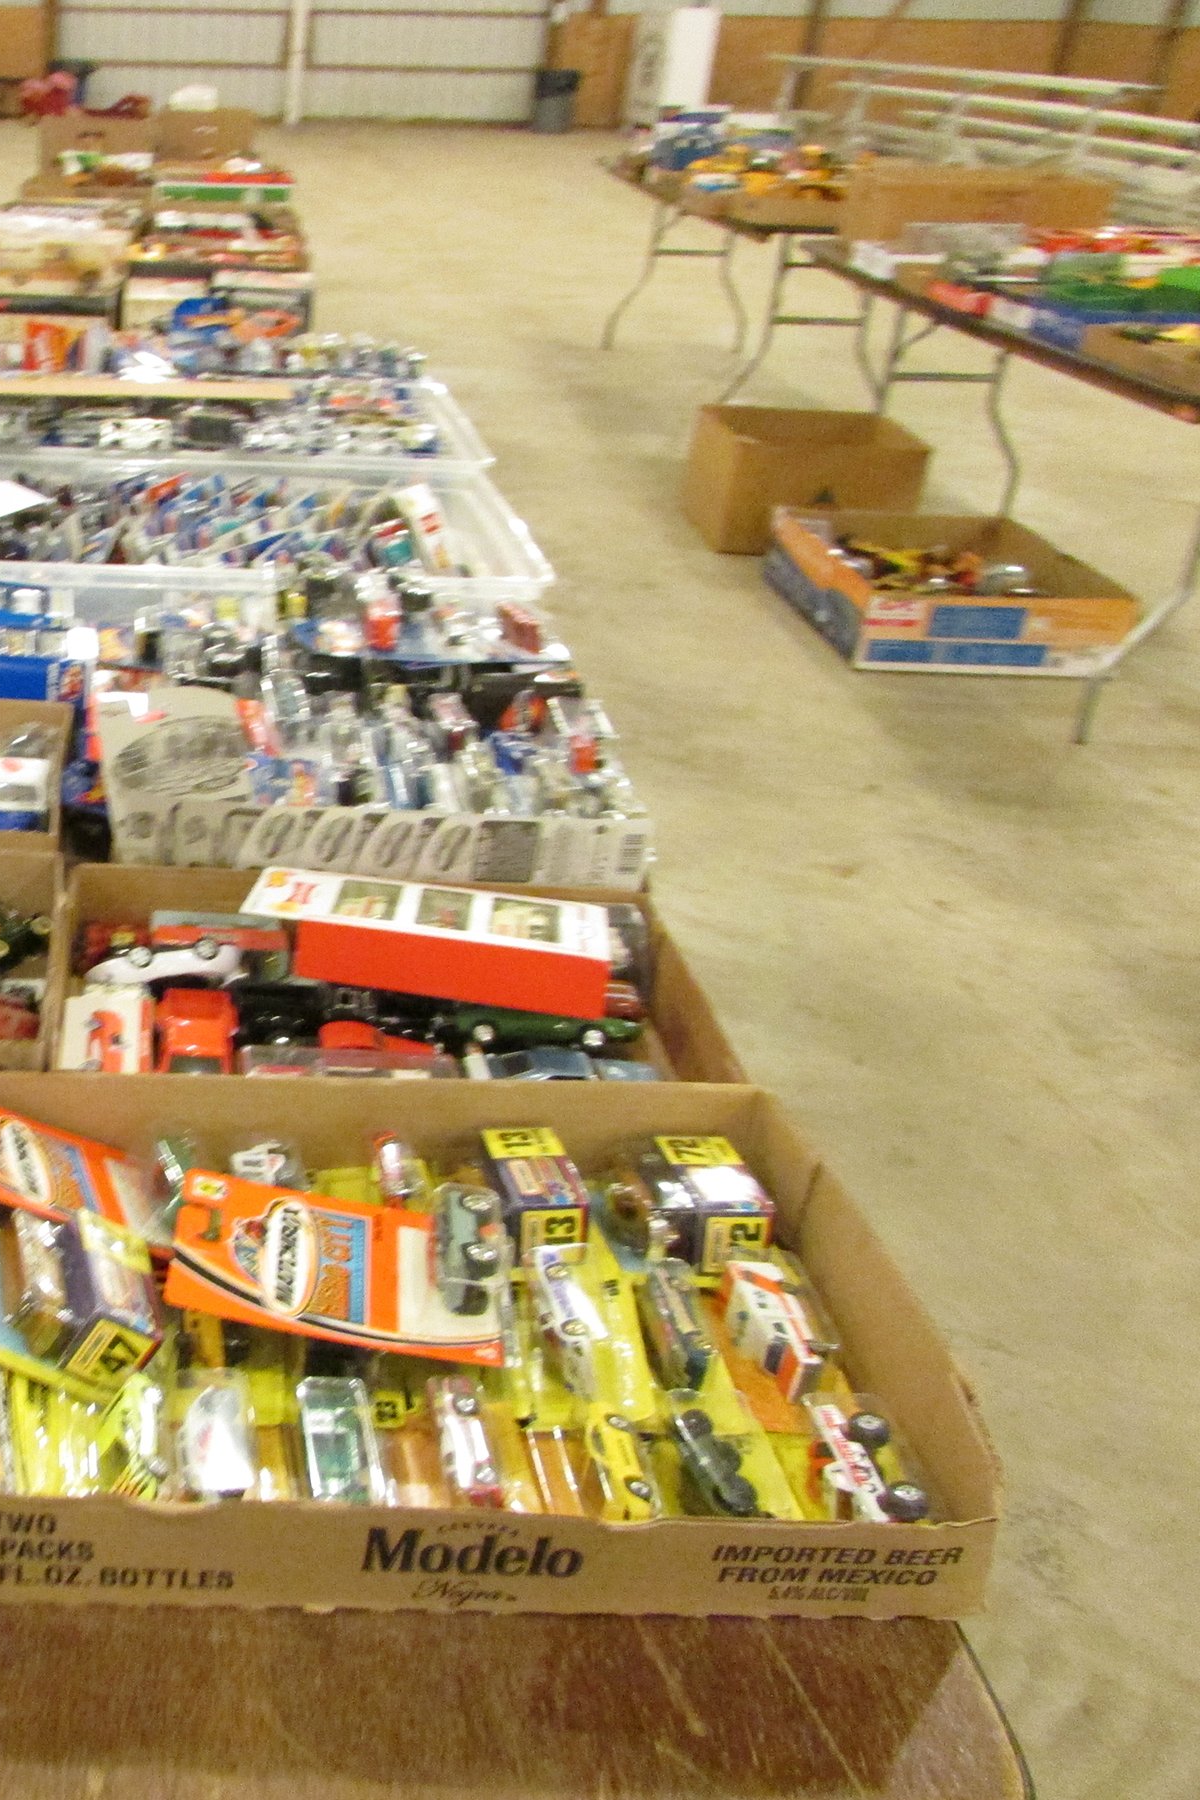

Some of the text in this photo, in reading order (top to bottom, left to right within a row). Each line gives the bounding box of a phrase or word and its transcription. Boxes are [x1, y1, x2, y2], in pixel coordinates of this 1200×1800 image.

[361, 1525, 584, 1578] Modelo
[711, 1545, 964, 1566] IMPORTED BEER
[99, 1566, 235, 1590] BOTTLES
[716, 1566, 938, 1586] FROM MEXICO
